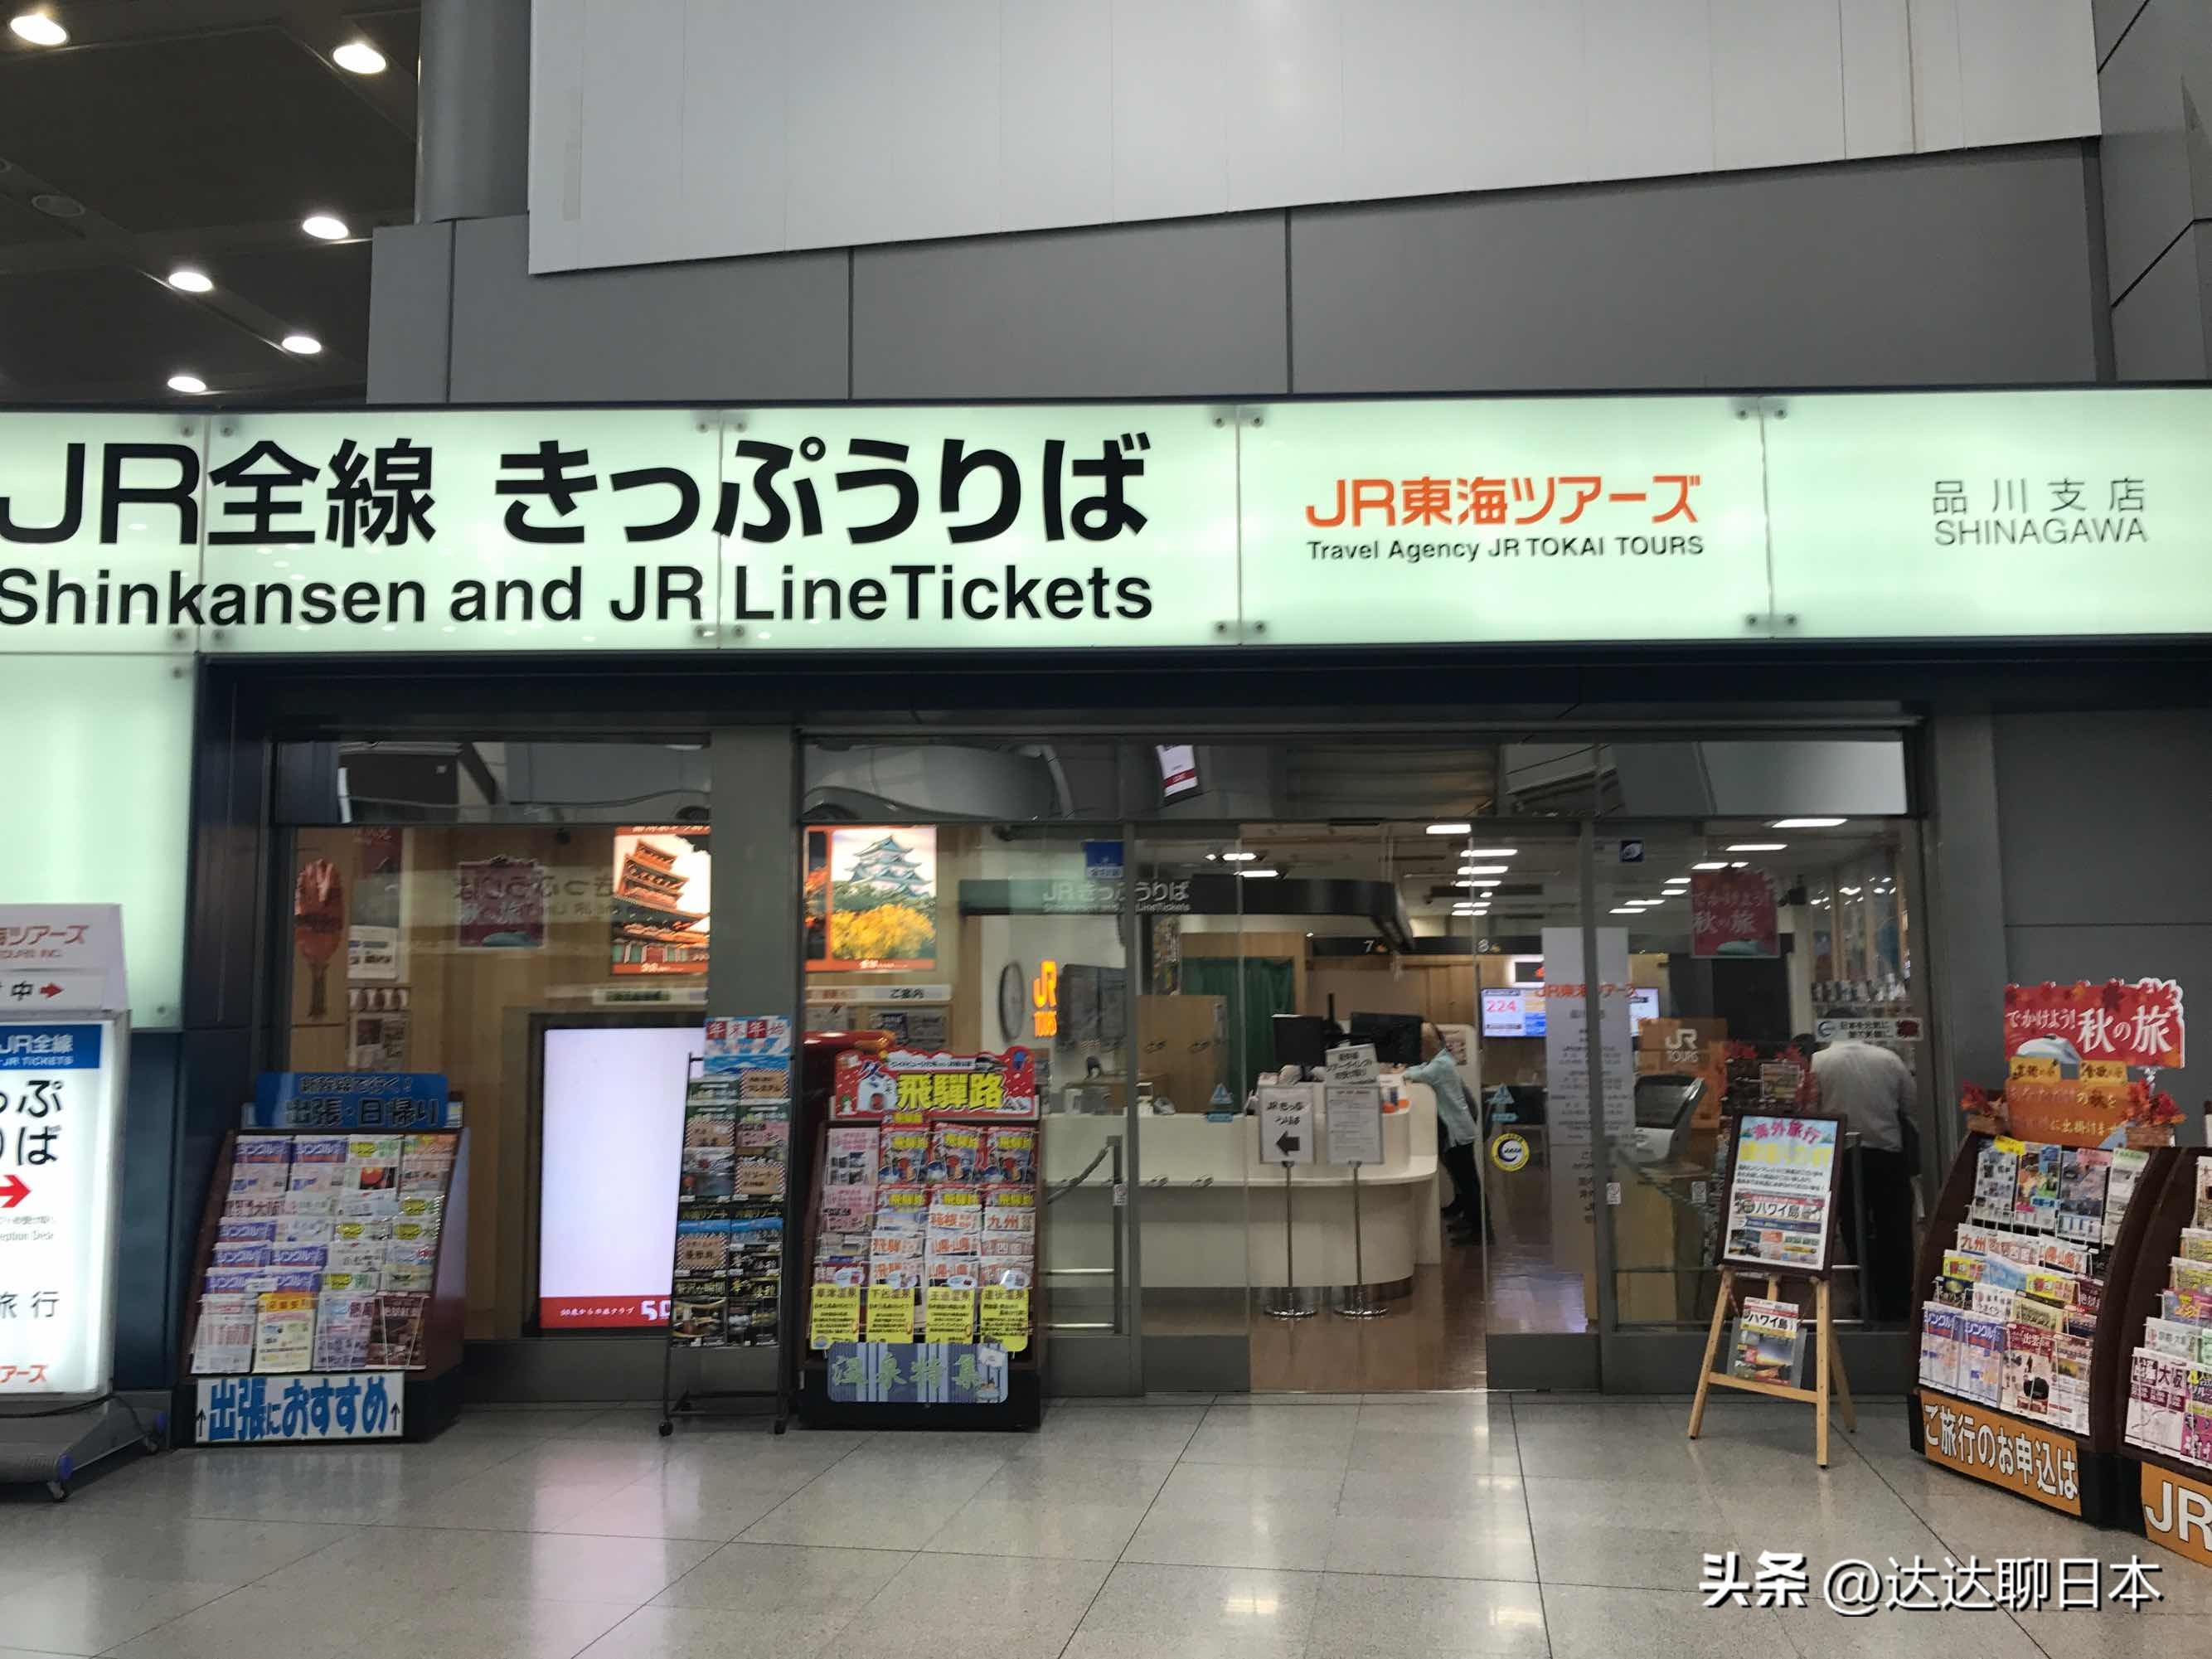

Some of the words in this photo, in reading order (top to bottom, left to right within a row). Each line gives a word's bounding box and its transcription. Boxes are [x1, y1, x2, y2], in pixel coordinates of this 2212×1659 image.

[0, 438, 437, 547] JR全線
[494, 432, 1151, 545] きっぷうりば
[1305, 476, 1701, 527] JR東海ツアーズ
[1933, 477, 2146, 516] 品川支店
[1306, 540, 1379, 560] Travel
[1387, 540, 1481, 564] Agency
[1487, 538, 1520, 558] JR
[1524, 536, 1605, 557] TOKAI
[1614, 535, 1705, 555] TOURS
[1933, 517, 2148, 546] SHINAGAWA
[0, 568, 426, 626] Shinkansen
[449, 566, 582, 623] and
[609, 565, 702, 622] JR
[0, 924, 90, 945] ツアーズ
[1486, 1000, 1517, 1013] 224
[1665, 1028, 1698, 1050] JR
[2077, 1004, 2174, 1055] 秋の旅
[0, 1125, 63, 1166] ば
[1753, 1119, 1822, 1145] 海外旅行
[208, 1375, 389, 1441] 出張におすすめ
[1923, 1404, 2079, 1501] ご旅行のお申込は
[2144, 1479, 2212, 1553] JR
